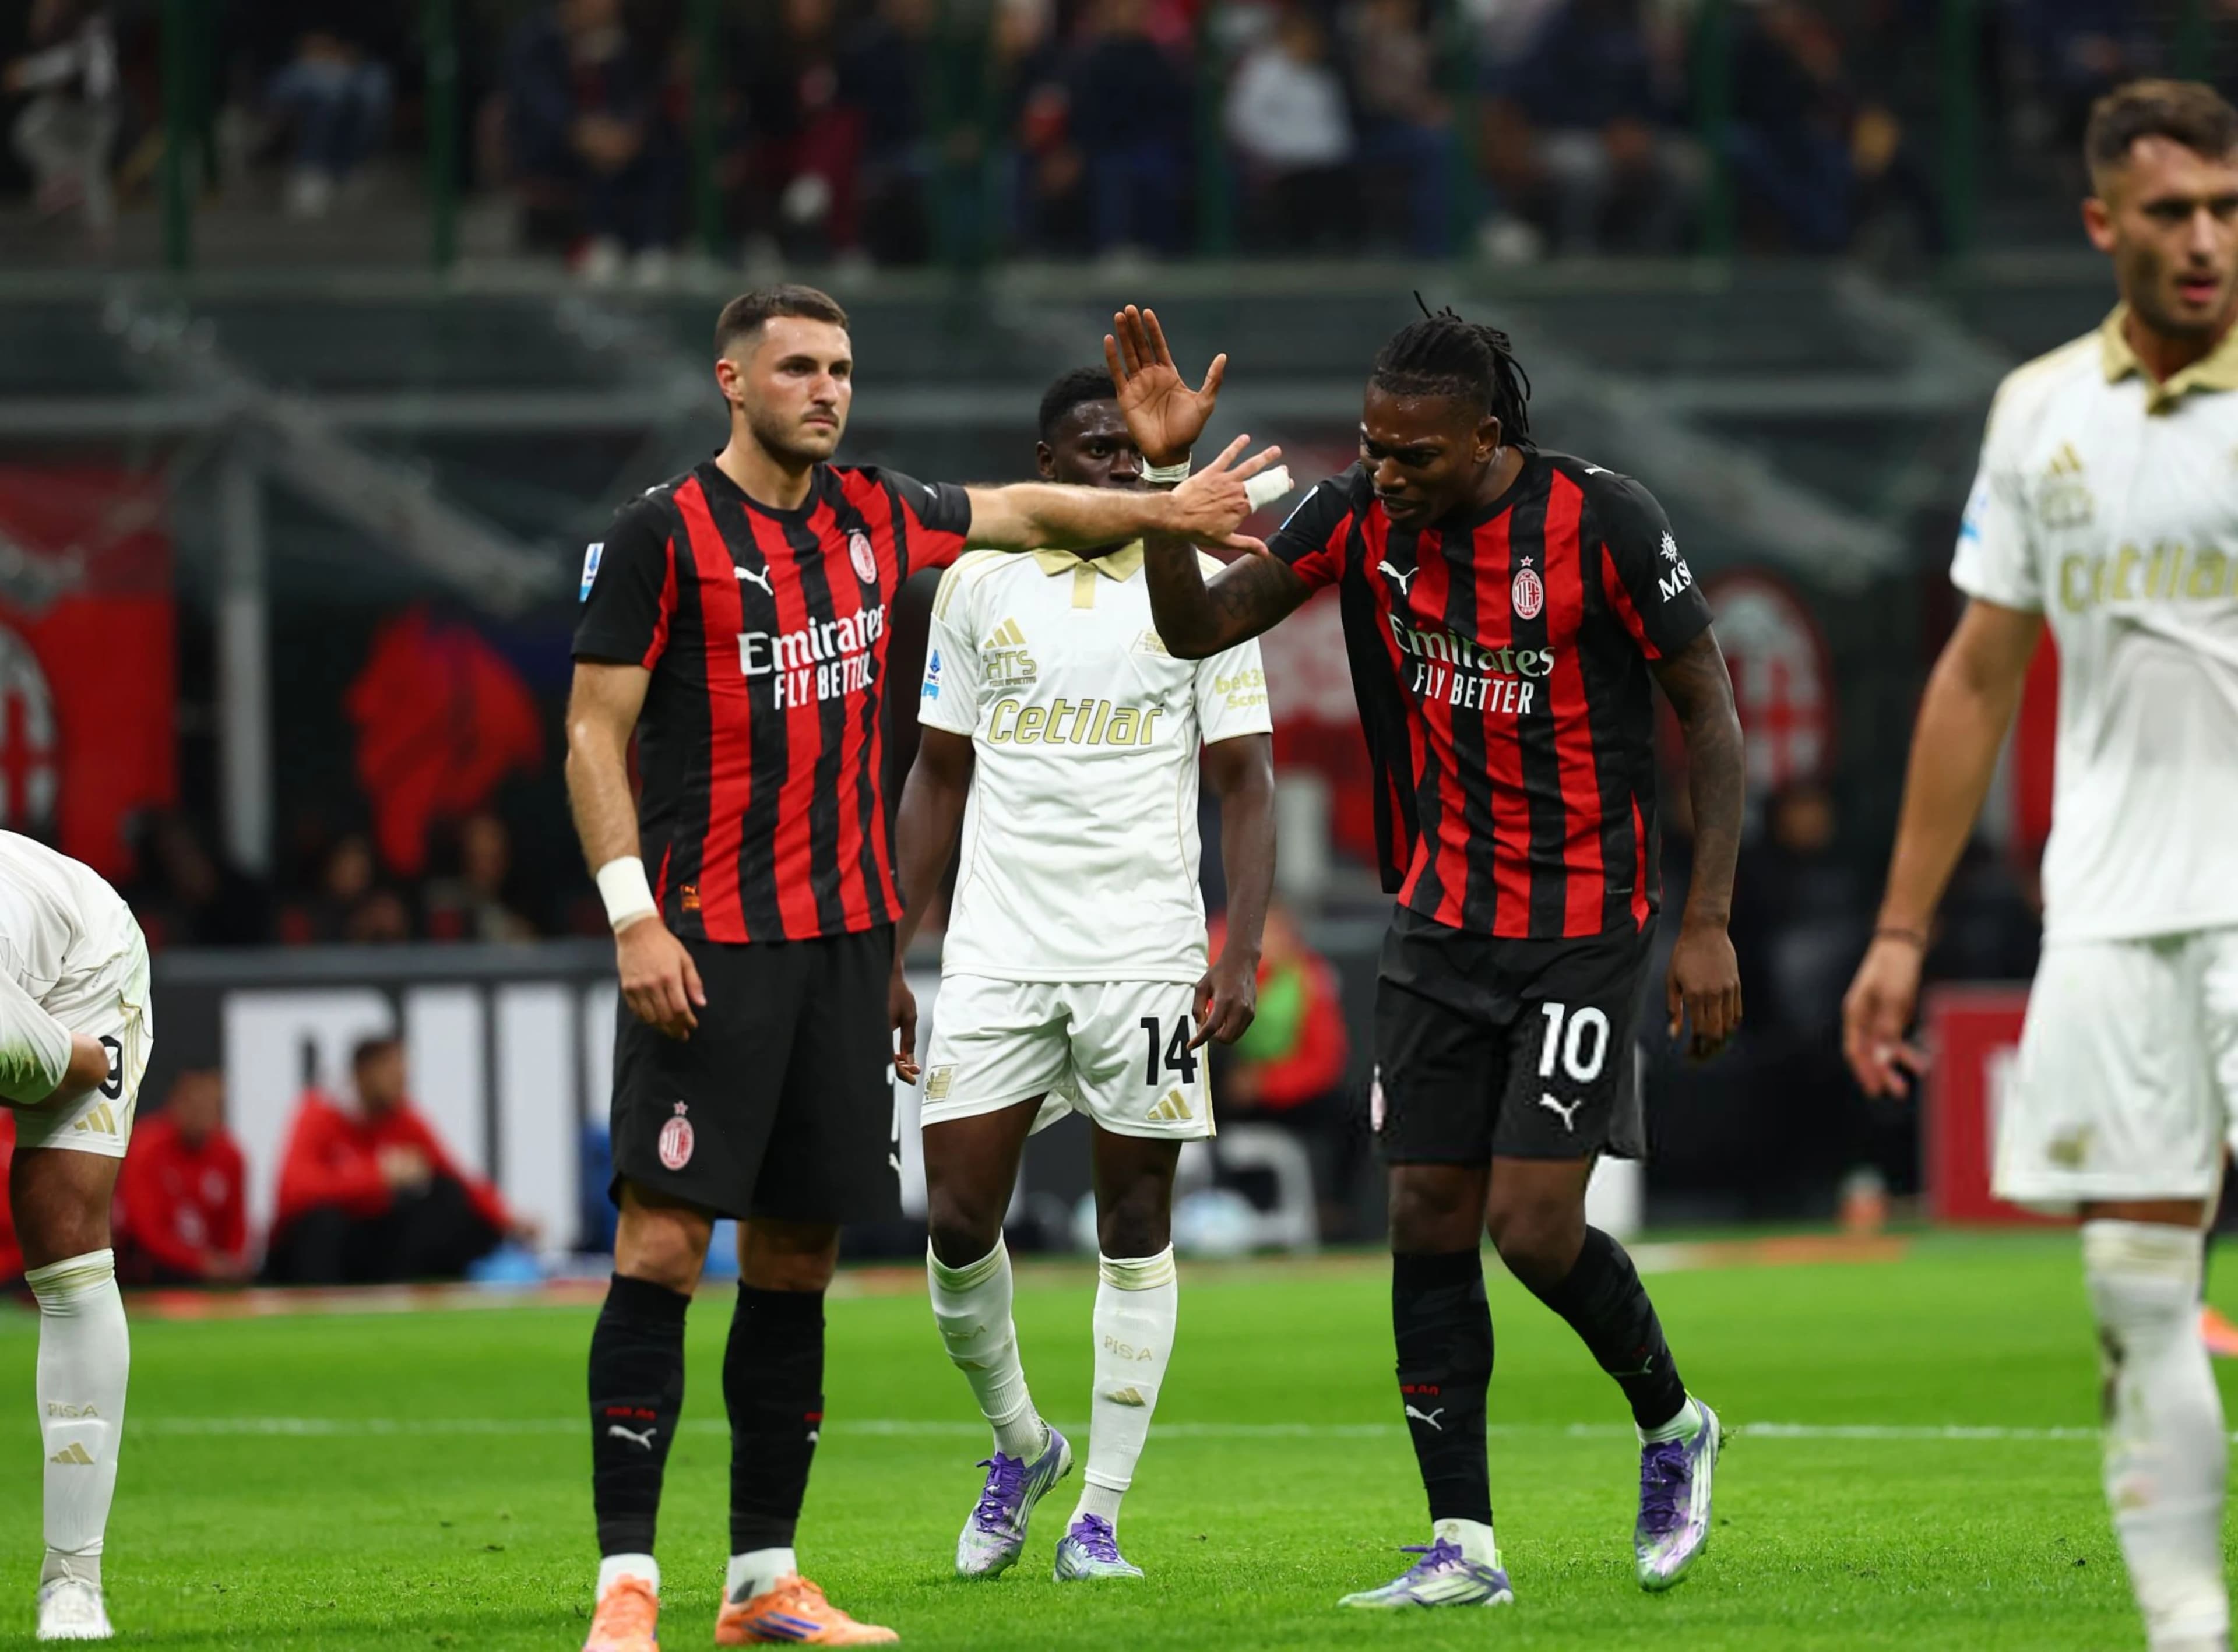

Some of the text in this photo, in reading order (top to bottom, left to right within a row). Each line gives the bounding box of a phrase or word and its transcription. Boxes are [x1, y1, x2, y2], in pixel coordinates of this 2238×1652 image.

[2060, 543, 2238, 614] Cetila
[737, 604, 885, 675] Emirates
[1388, 612, 1555, 677] Emirates
[774, 669, 810, 710] FLY
[1226, 693, 1268, 710] Scor
[1412, 663, 1534, 714] FLY BETTER
[987, 699, 1163, 746] Cetilar
[1141, 1015, 1198, 1086] 14
[1539, 1002, 1610, 1082] 10
[1104, 1334, 1152, 1362] PISA
[48, 1403, 98, 1418] PISA
